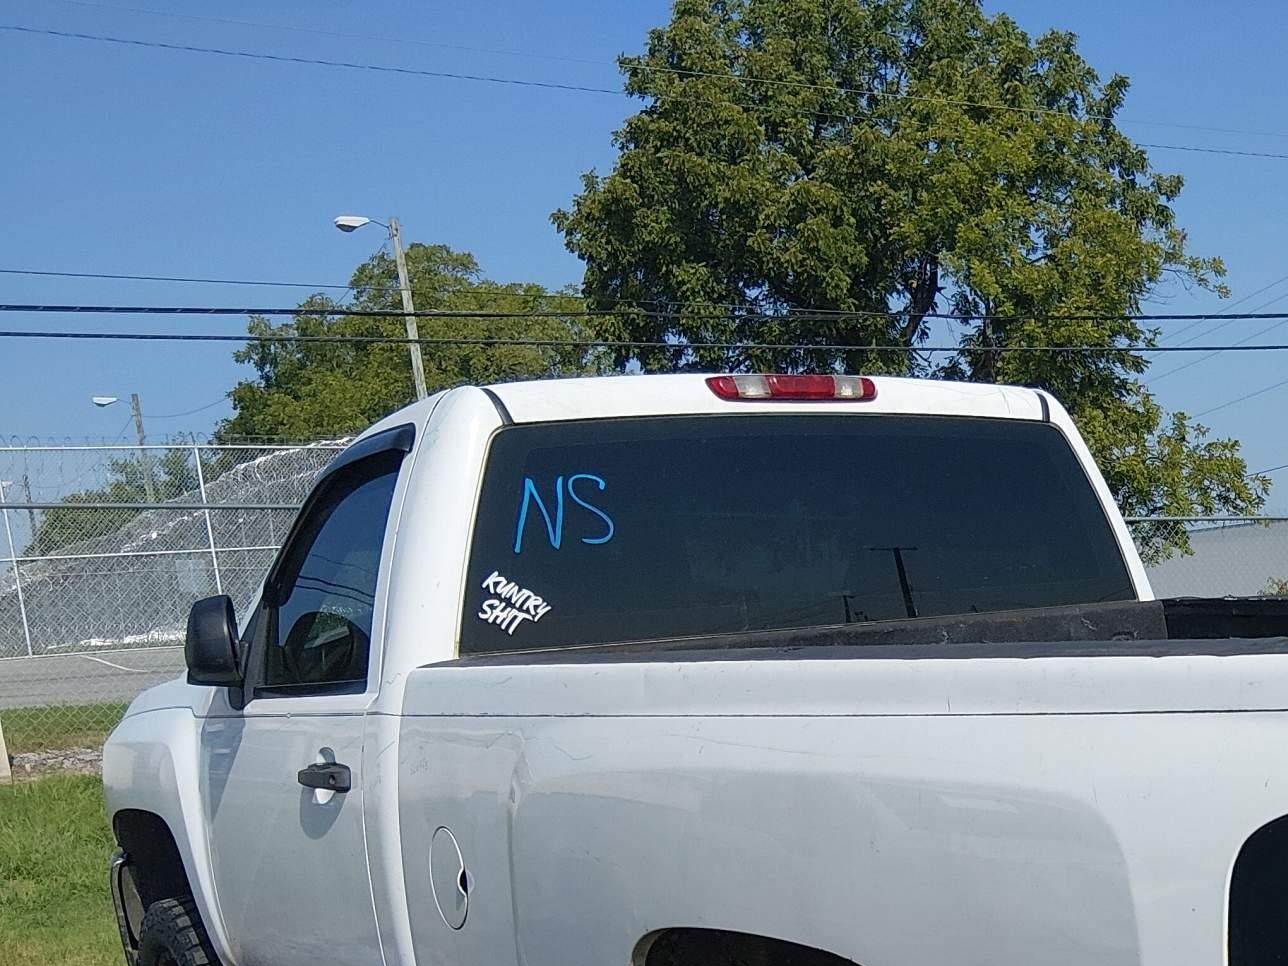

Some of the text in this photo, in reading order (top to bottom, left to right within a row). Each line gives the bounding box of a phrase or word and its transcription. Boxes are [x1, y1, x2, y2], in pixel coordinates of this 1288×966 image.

[514, 473, 615, 554] NS
[478, 598, 534, 636] SHIT
[481, 570, 552, 623] KUNTRY
